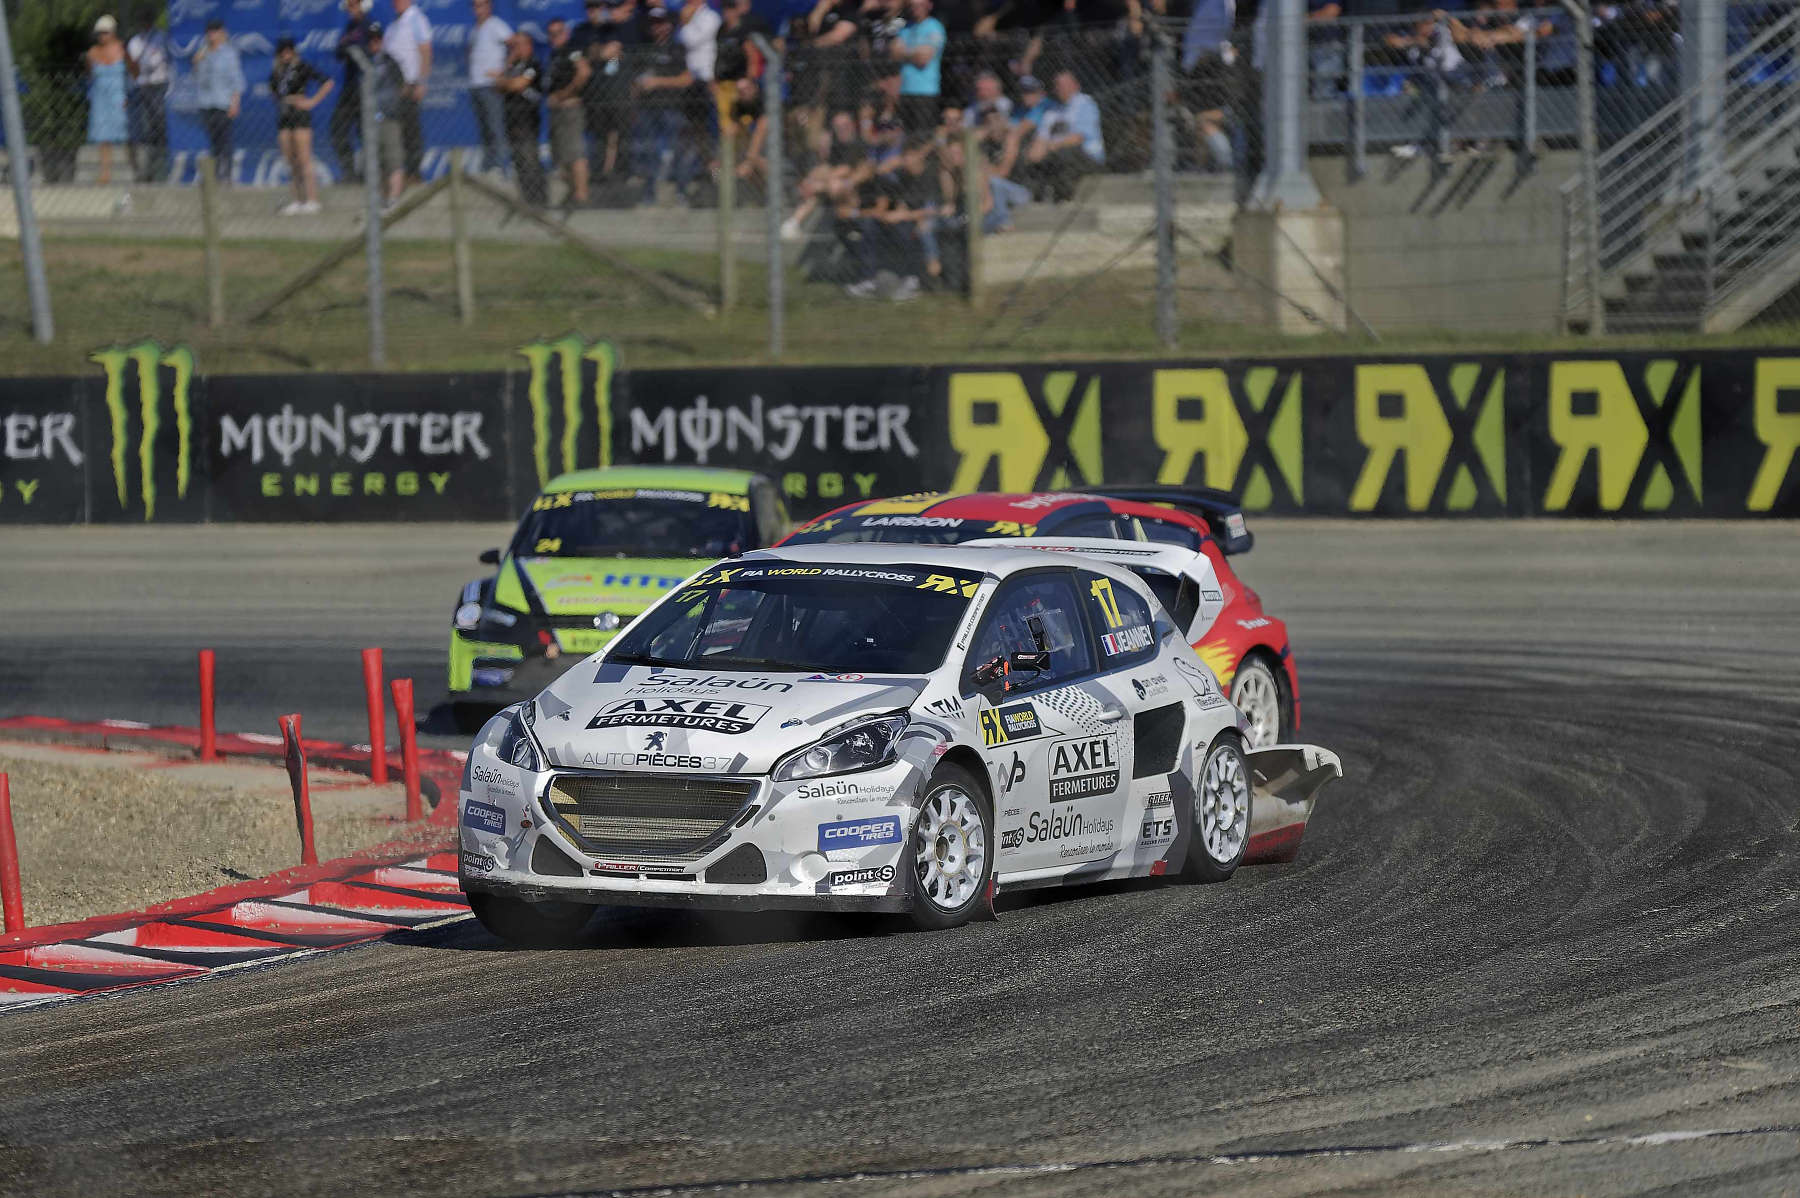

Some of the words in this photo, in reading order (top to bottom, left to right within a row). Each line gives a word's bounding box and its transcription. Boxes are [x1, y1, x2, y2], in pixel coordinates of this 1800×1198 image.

[220, 403, 490, 465] MONSTER
[630, 395, 918, 462] MONSTER
[261, 472, 451, 497] ENERGY
[783, 472, 879, 497] RGY
[861, 517, 963, 528] LARSSON
[768, 568, 822, 576] WORLD
[822, 569, 916, 582] RALLYCROSS
[1090, 578, 1124, 628] 17
[624, 687, 720, 695] Holidays
[638, 674, 793, 693] Salaün
[606, 700, 752, 721] AXEL
[1012, 711, 1034, 721] WORLD
[596, 714, 744, 733] FERMETURES
[1007, 720, 1037, 732] RALLYCROSS
[582, 752, 732, 770] AUTOPIÈCES37
[1053, 739, 1117, 776] AXEL
[472, 765, 502, 785] Salaün
[797, 781, 858, 799] Salaün
[860, 785, 894, 794] Holidays
[1052, 774, 1117, 797] FERMETURES
[1148, 793, 1173, 806] GREEN
[468, 806, 503, 821] COOPER
[484, 818, 503, 828] TIRES
[825, 822, 895, 838] COOPER
[1027, 806, 1082, 842] Salaün
[1083, 817, 1114, 835] Holidays
[1142, 819, 1173, 838] ETS
[859, 832, 893, 841] TIRES
